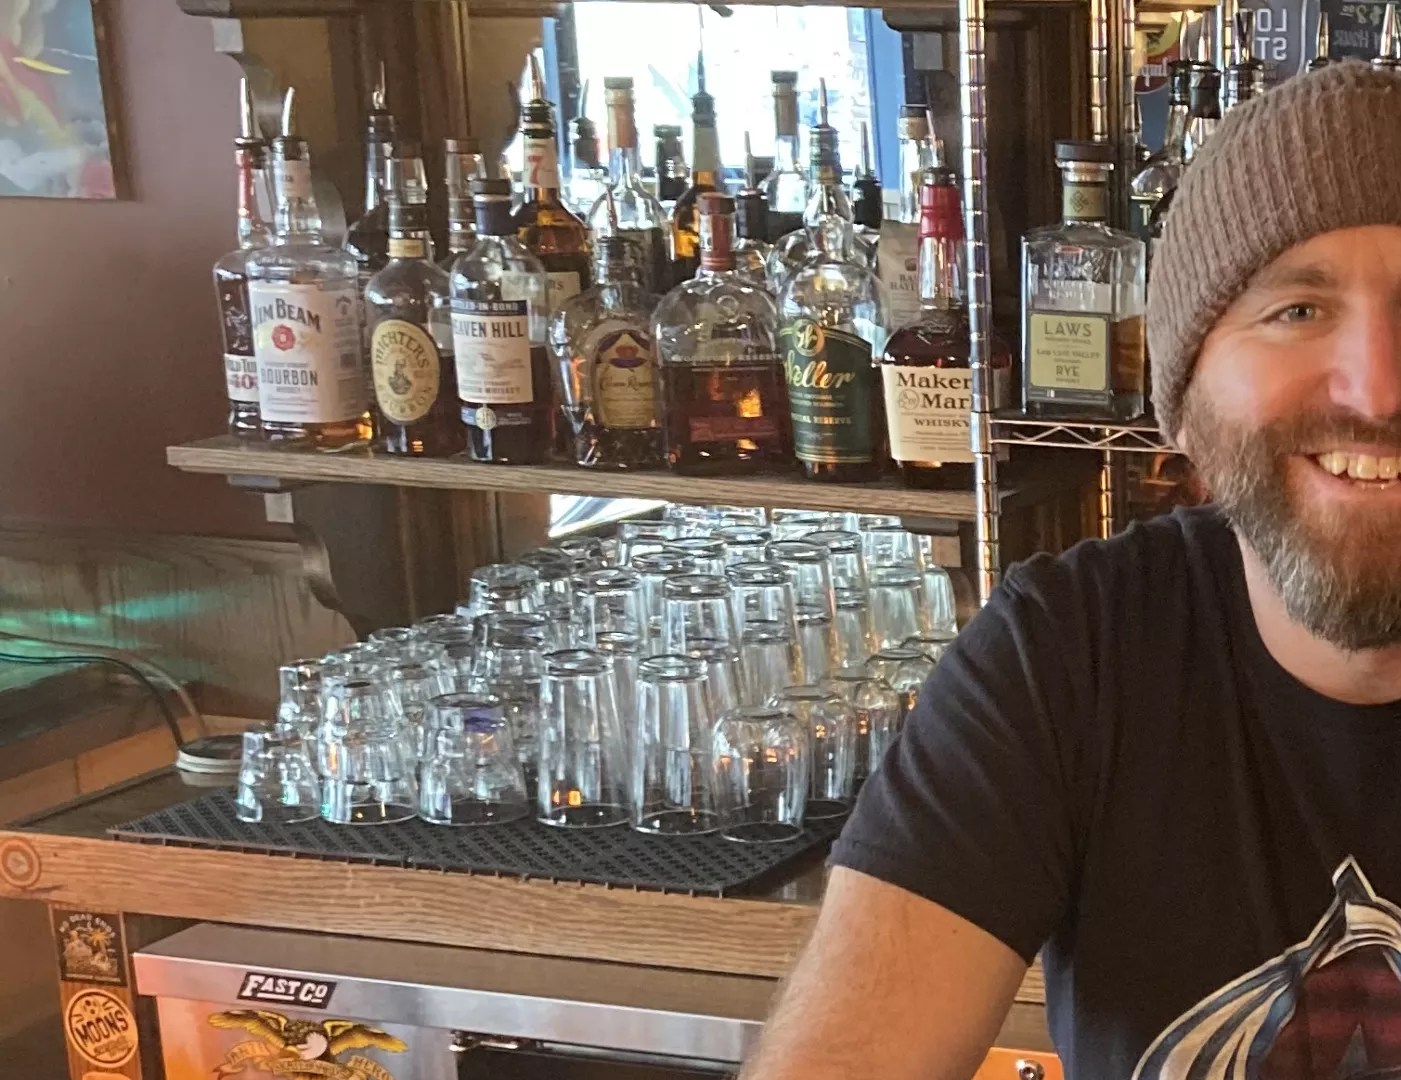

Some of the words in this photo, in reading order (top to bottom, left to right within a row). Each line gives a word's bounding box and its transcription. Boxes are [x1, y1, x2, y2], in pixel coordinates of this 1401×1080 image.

[274, 297, 322, 334] BEAM
[491, 320, 525, 338] HILL
[1043, 320, 1093, 338] LAWS
[260, 366, 320, 387] BOURBON
[1055, 364, 1080, 378] RYE
[240, 974, 302, 998] FAST
[75, 1008, 129, 1048] MOONS
